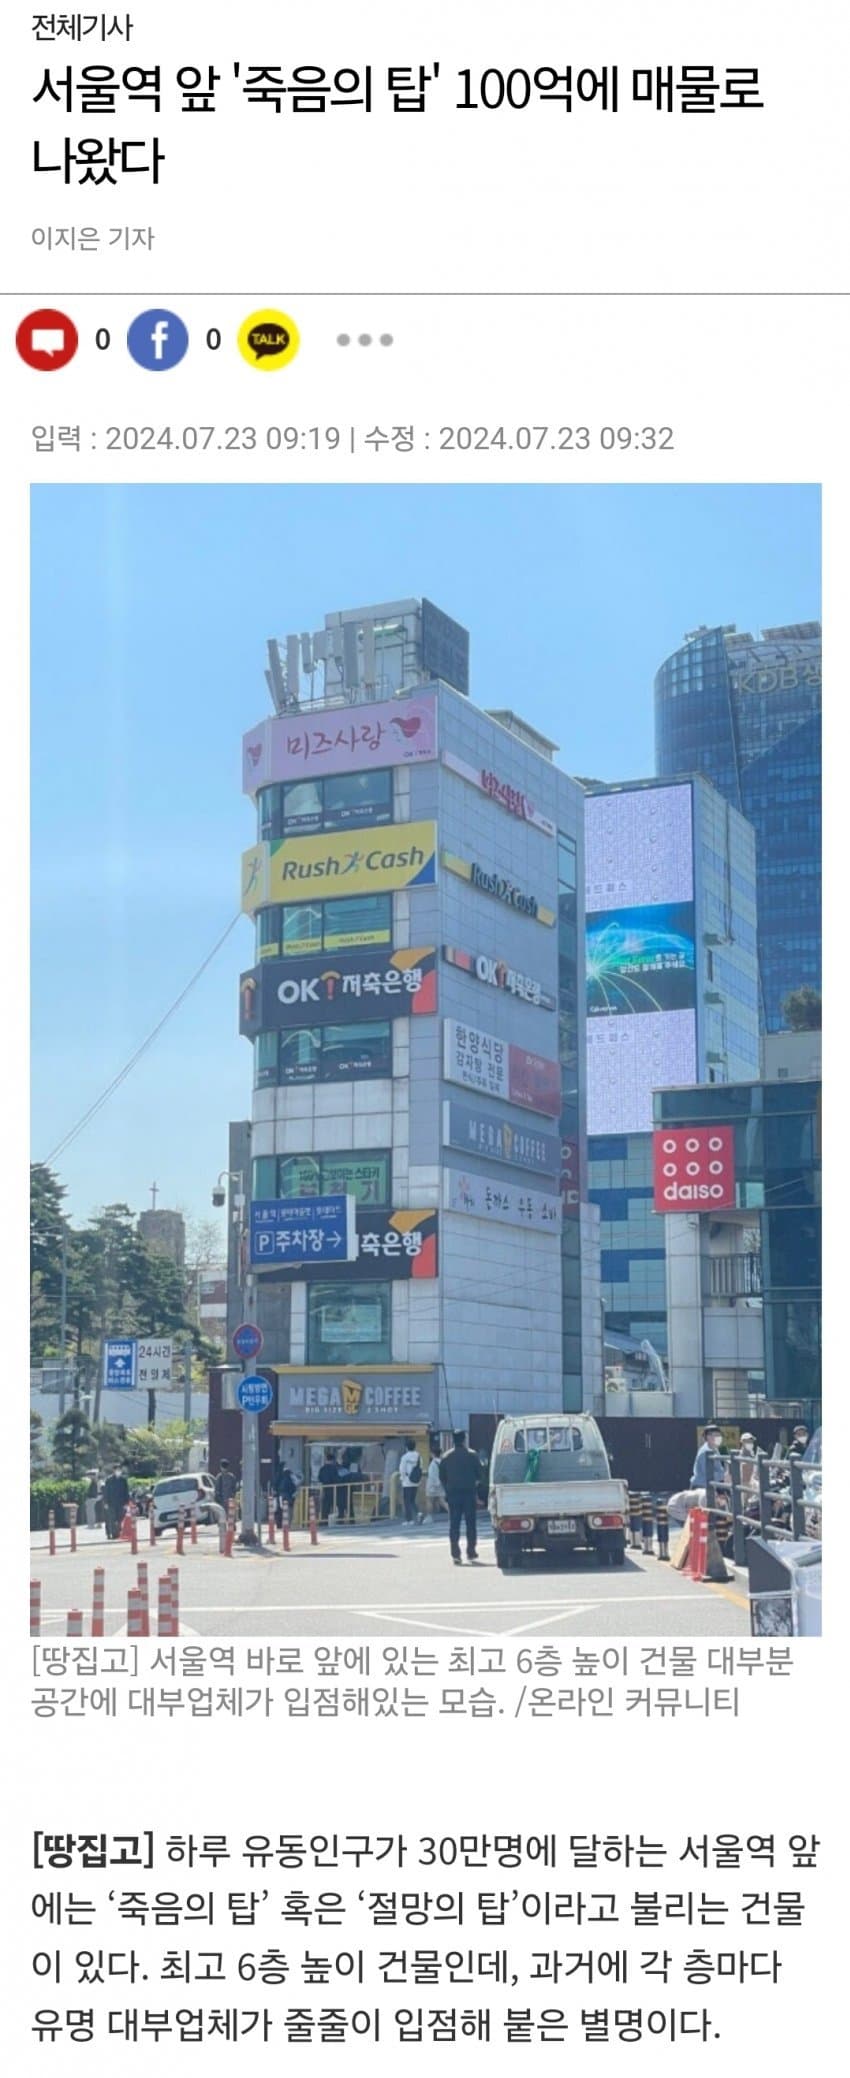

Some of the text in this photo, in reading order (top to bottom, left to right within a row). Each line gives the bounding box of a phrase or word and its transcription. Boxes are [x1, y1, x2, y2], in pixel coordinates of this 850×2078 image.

[287, 720, 384, 760] 미즈사랑
[282, 846, 424, 881] Rush Cash
[473, 862, 502, 896] Rush
[343, 968, 422, 998] 저축은행
[456, 1025, 504, 1065] 한양식당
[456, 1051, 483, 1075] 감자탕
[488, 1062, 504, 1082] 전문
[663, 1181, 724, 1200] daiso
[259, 1229, 325, 1253] P 주차장
[355, 1231, 422, 1257] 축은행
[138, 1345, 171, 1358] 24시간
[289, 1386, 341, 1406] MEGA
[365, 1386, 422, 1406] COFFEE
